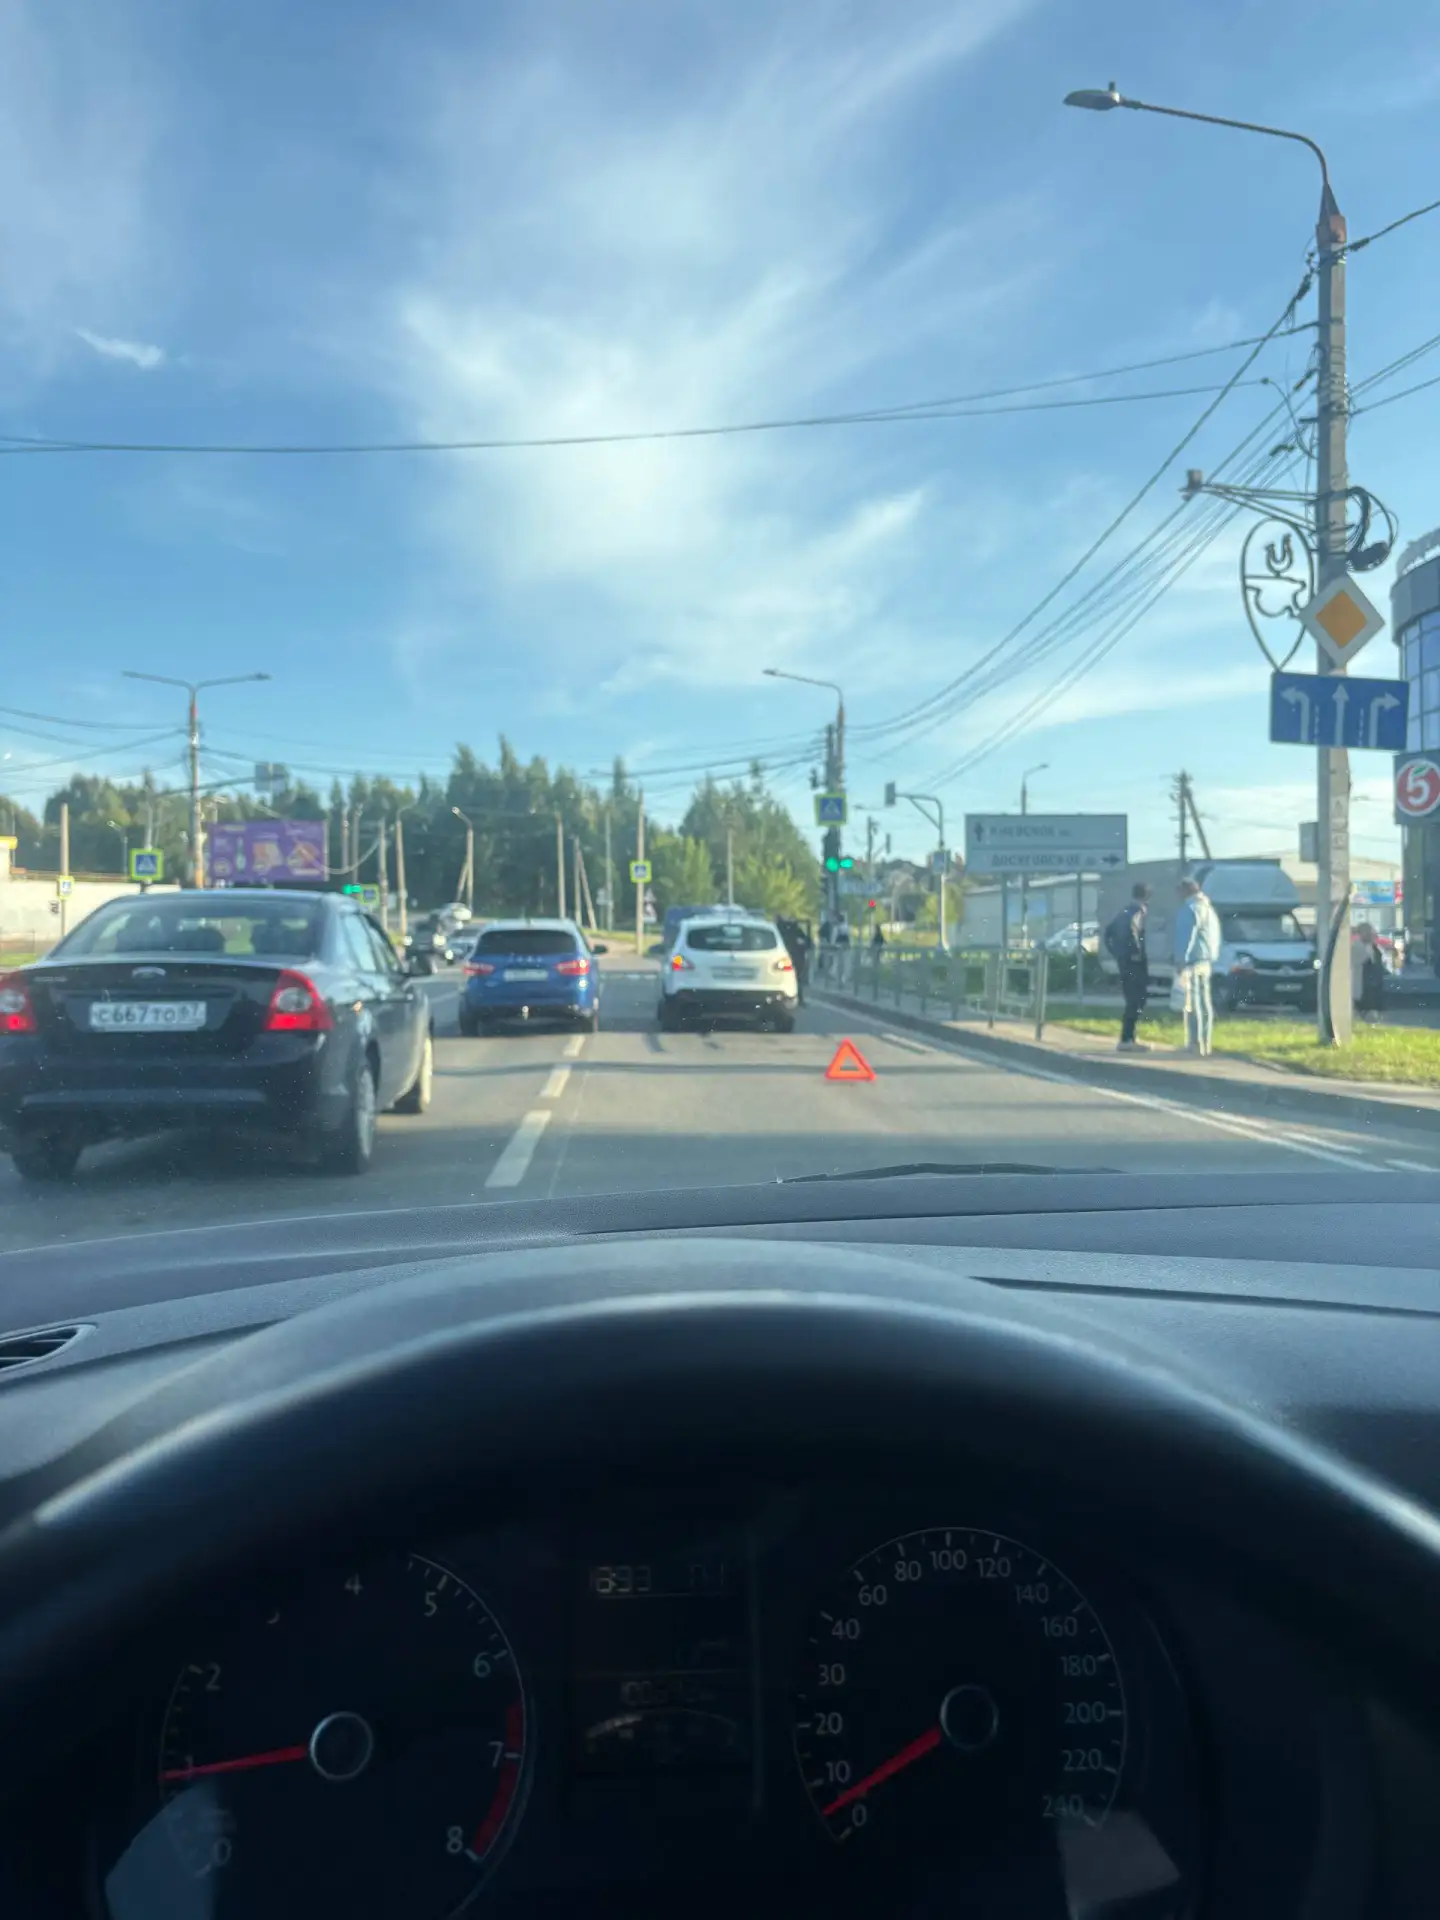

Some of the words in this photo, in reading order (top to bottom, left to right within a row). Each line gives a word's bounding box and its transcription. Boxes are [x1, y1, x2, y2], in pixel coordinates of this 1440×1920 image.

[1406, 766, 1431, 806] 5
[894, 1560, 922, 1582] 80
[931, 1550, 967, 1571] 100
[977, 1556, 1011, 1578] 120
[345, 1573, 363, 1596] 4
[858, 1584, 887, 1606] 60
[1015, 1582, 1050, 1604] 140
[423, 1592, 438, 1617] 5
[831, 1617, 861, 1640] 40
[1042, 1616, 1078, 1638] 160
[473, 1652, 491, 1678] 6
[818, 1664, 846, 1686] 30
[1061, 1655, 1097, 1677] 180
[204, 1663, 222, 1692] 2
[814, 1713, 844, 1735] 20
[1064, 1701, 1107, 1724] 200
[488, 1741, 504, 1767] 7
[1062, 1749, 1102, 1771] 220
[826, 1760, 851, 1783] 10
[852, 1804, 867, 1827] 0
[446, 1826, 463, 1853] 8
[212, 1838, 233, 1866] 0
